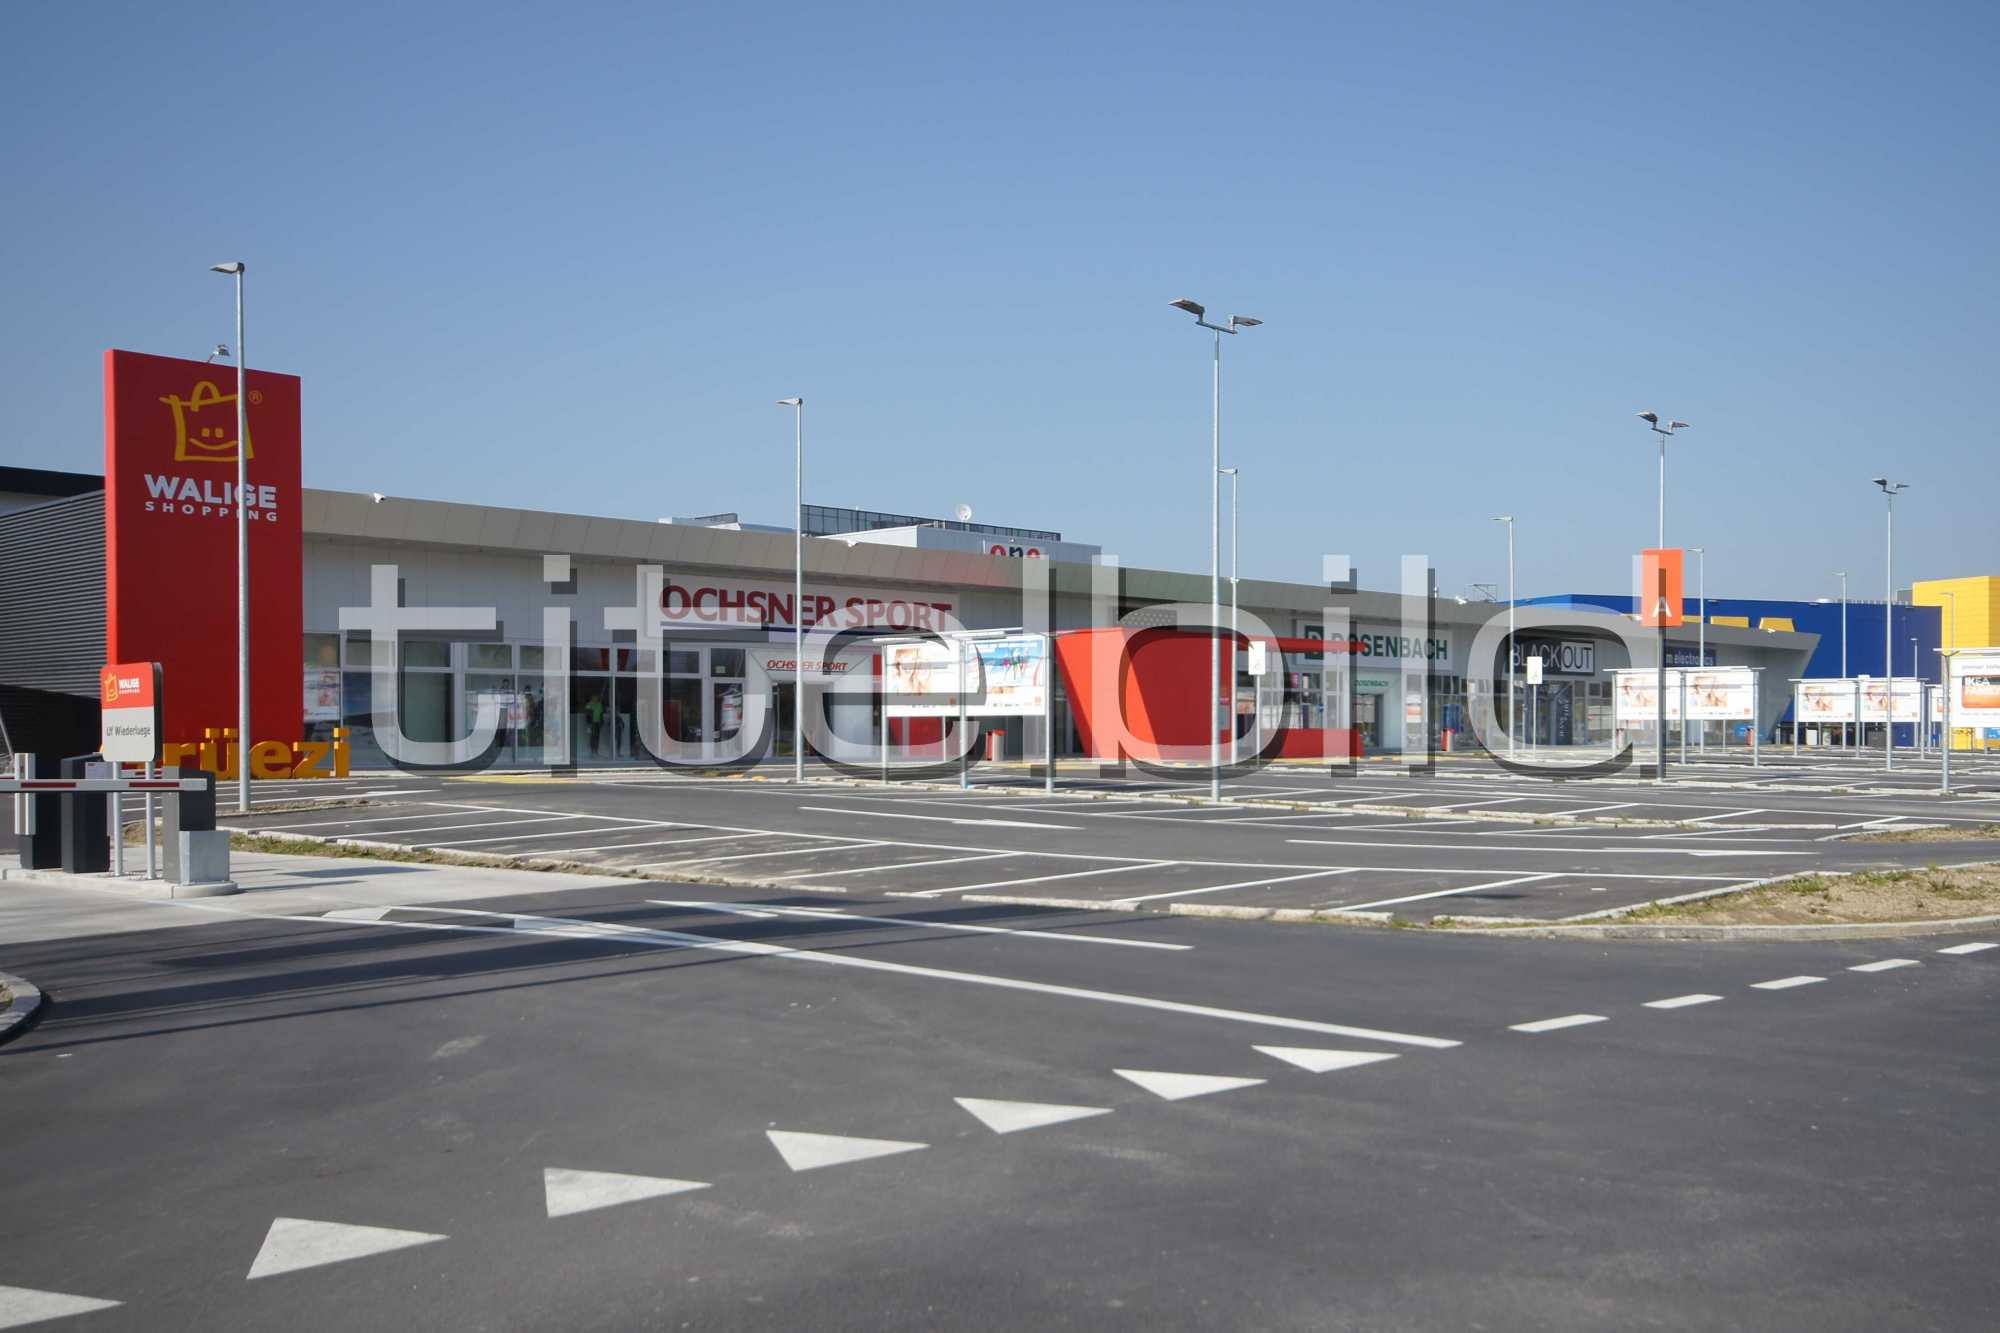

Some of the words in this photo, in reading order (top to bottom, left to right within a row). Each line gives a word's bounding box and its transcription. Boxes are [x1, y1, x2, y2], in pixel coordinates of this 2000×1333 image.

[144, 473, 277, 509] WALIGE
[145, 501, 277, 522] SHOPPING
[659, 585, 837, 627] OCHSNER
[846, 597, 952, 631] SPORT
[1652, 596, 1672, 617] A
[99, 728, 351, 779] rüezi
